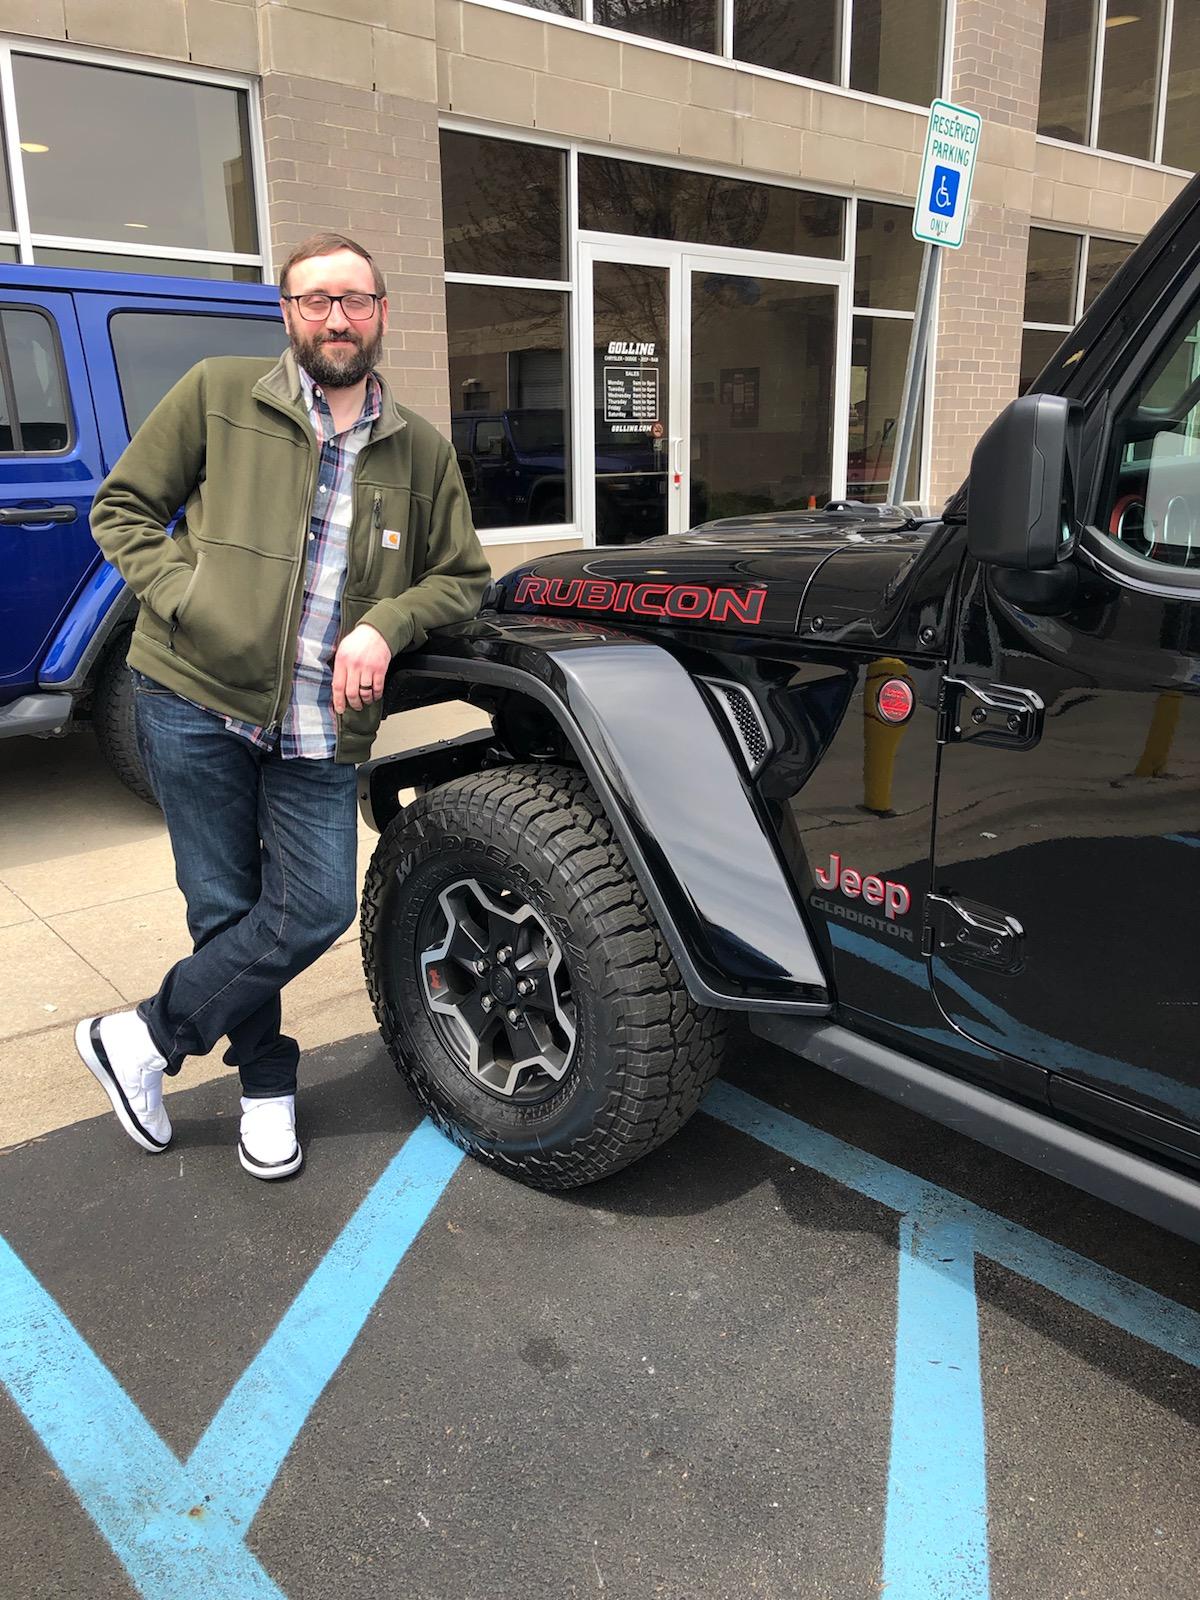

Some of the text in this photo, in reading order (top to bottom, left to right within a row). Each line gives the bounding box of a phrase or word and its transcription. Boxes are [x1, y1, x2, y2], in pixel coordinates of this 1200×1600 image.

[932, 114, 976, 144] RESERVED
[932, 139, 970, 167] PARKING
[930, 218, 949, 233] ONLY
[608, 341, 655, 355] GOLLING
[514, 577, 767, 624] RUBICON
[815, 851, 911, 920] Jeep
[810, 895, 914, 942] GLADIATOR
